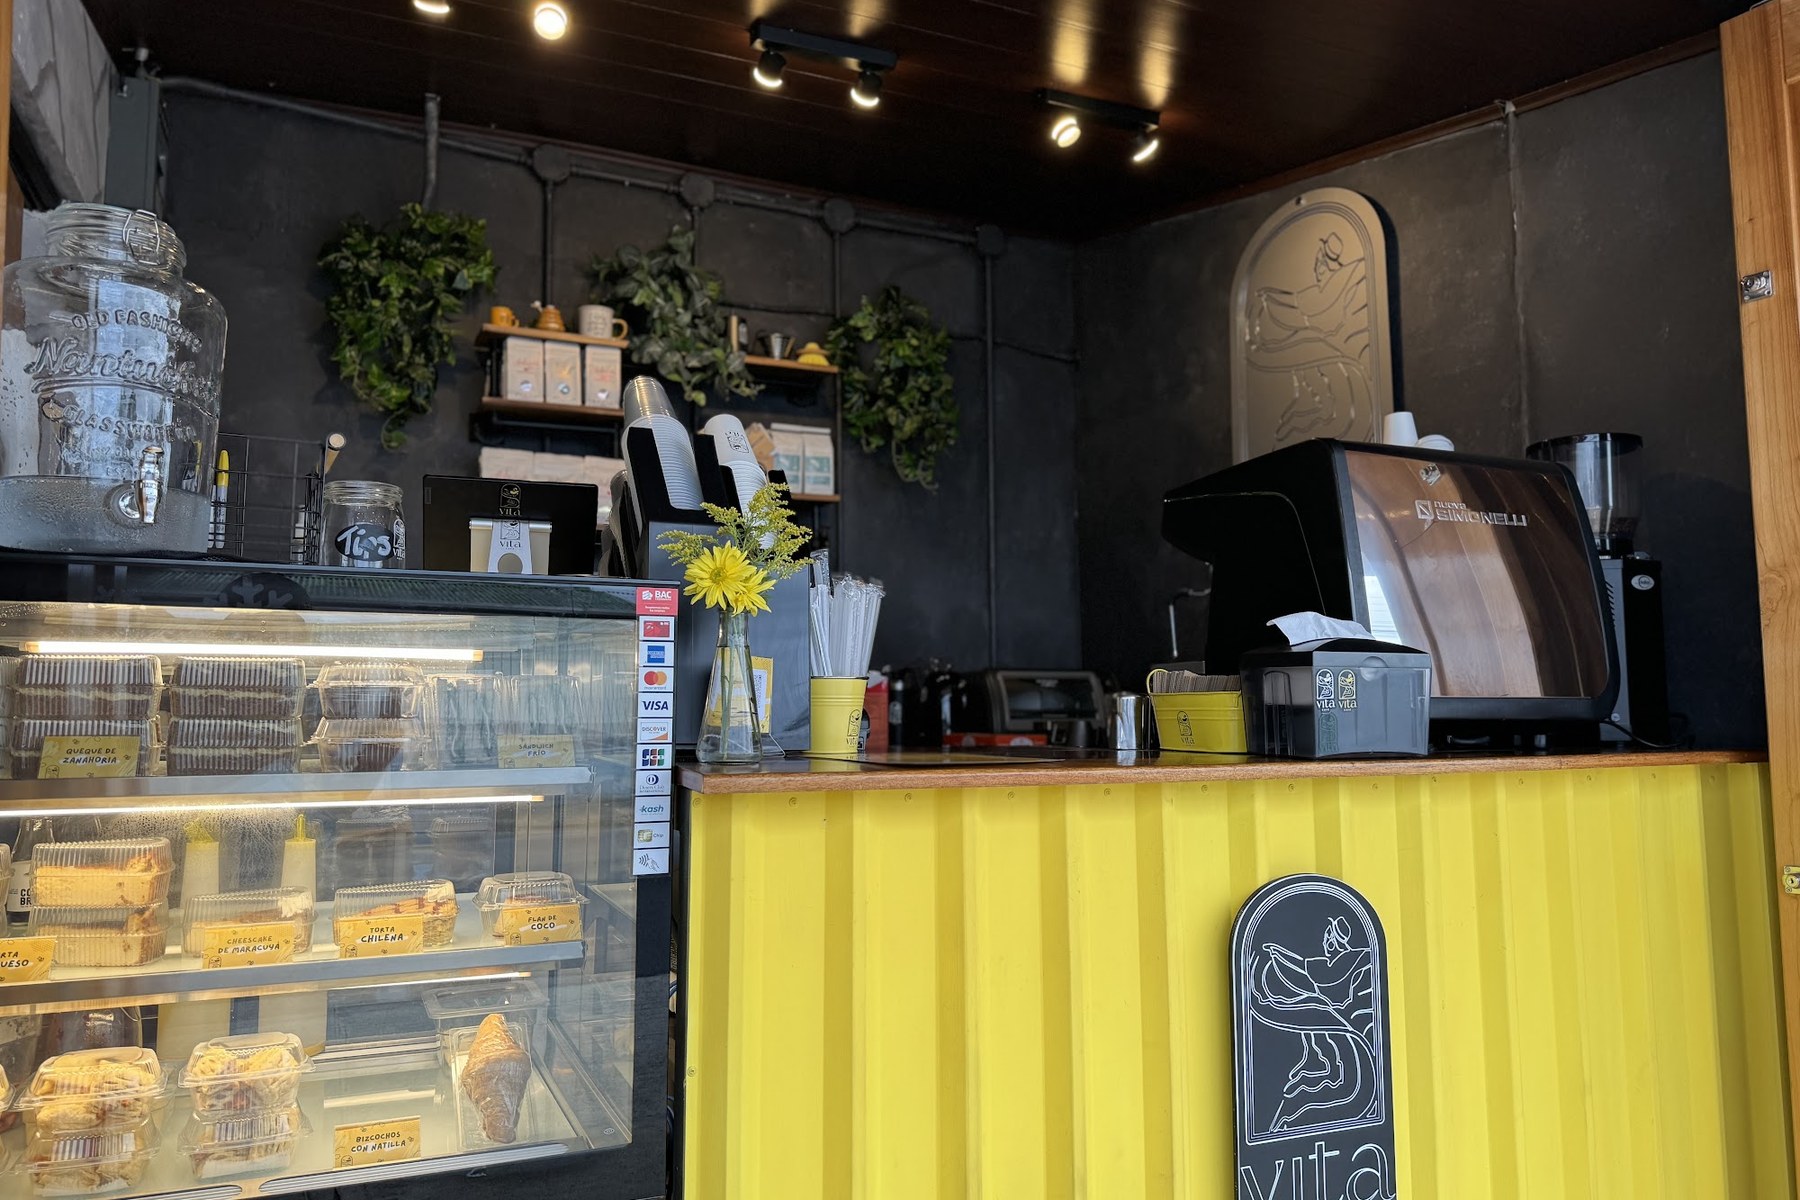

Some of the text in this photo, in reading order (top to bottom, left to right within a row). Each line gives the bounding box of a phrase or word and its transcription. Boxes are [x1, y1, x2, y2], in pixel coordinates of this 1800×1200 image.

[499, 508, 521, 516] vita
[1435, 509, 1527, 526] SIMONELLI
[499, 540, 521, 548] vita
[655, 590, 672, 599] BAC
[641, 700, 669, 711] VISA
[1316, 699, 1358, 709] vita vita
[66, 747, 117, 755] QUEQUE DE
[63, 756, 117, 765] ZANAHORIA
[640, 804, 664, 813] kash
[369, 926, 395, 934] TORTA
[531, 922, 556, 930] COCO
[227, 936, 273, 945] CHEESCAKE
[361, 933, 404, 943] CHILENA
[0, 951, 19, 959] RTA
[0, 959, 30, 968] UESO
[355, 1131, 401, 1143] BIZCOCHOS
[351, 1140, 407, 1153] CON NATILLA
[1241, 1141, 1396, 1200] vita
